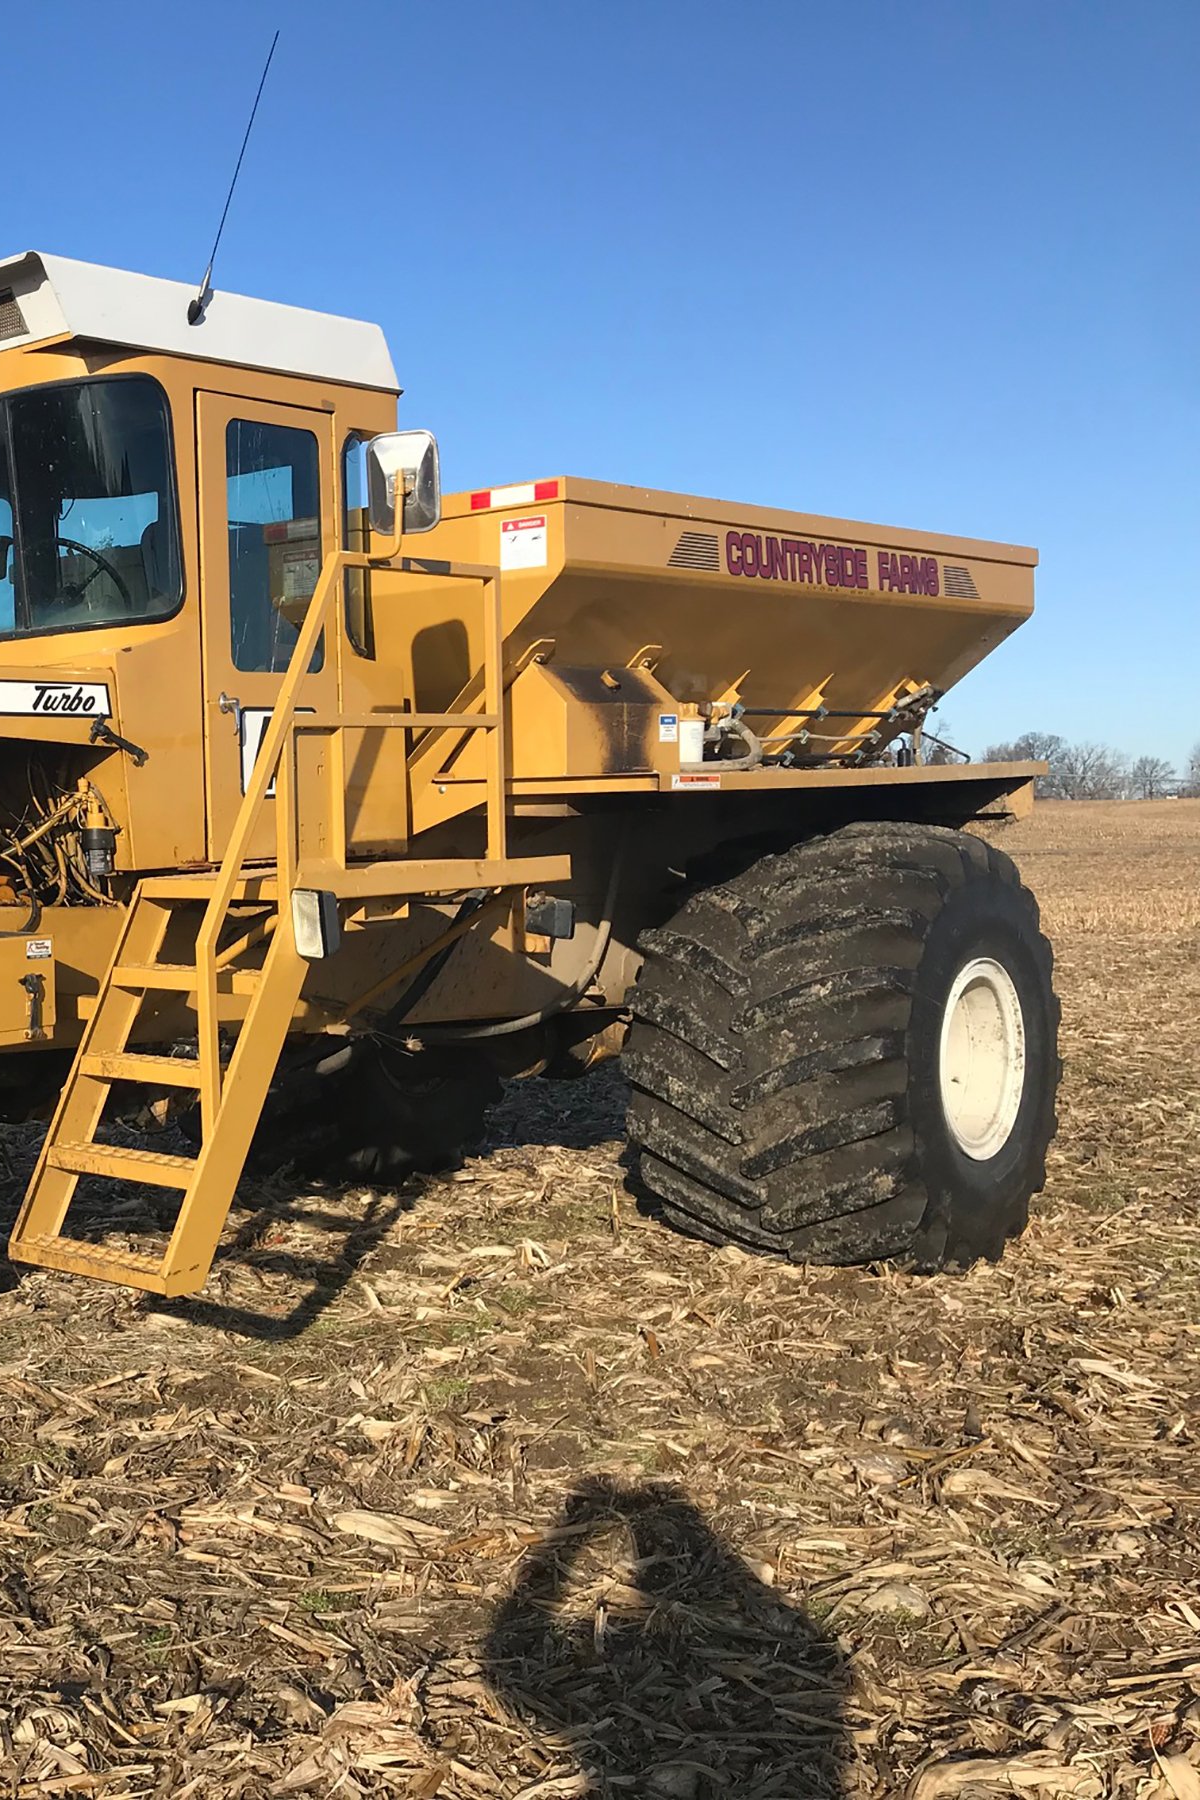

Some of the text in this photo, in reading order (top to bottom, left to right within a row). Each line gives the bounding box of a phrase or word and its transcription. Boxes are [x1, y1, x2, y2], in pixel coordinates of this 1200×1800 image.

[726, 531, 940, 597] COUNTRYSIDE FARMS
[31, 685, 96, 713] Turbo
